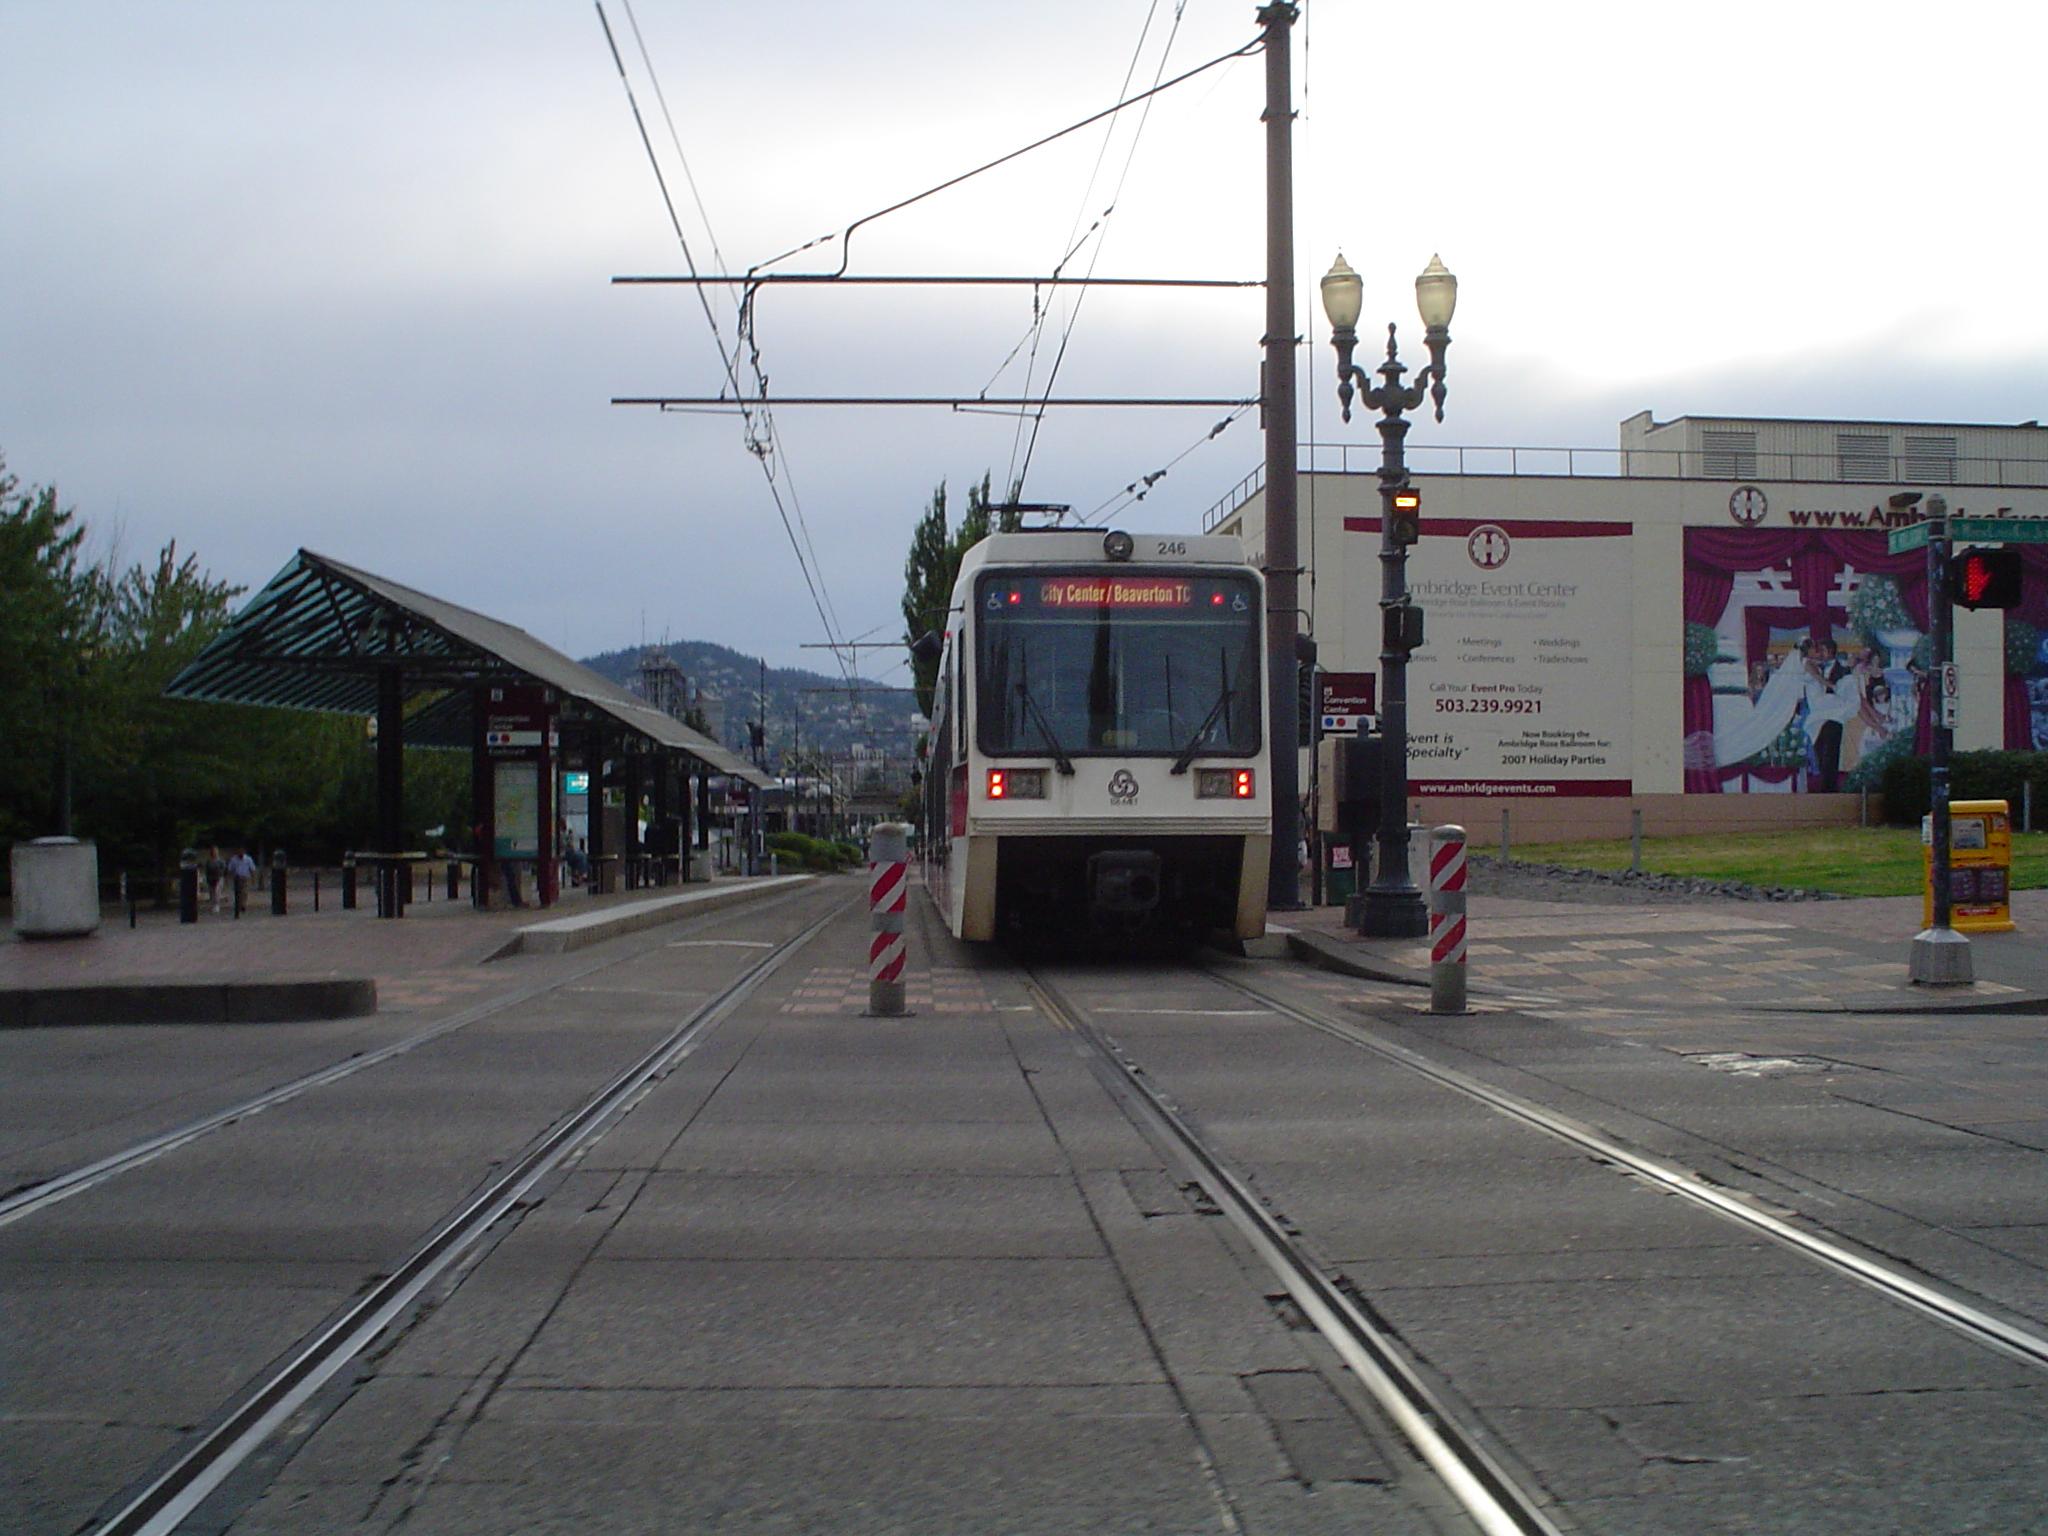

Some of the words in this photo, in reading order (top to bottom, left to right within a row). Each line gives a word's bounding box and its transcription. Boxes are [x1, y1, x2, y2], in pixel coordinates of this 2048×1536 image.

[1158, 542, 1187, 555] 246
[1041, 585, 1063, 605] City
[1067, 584, 1105, 602] Center
[1114, 585, 1173, 602] Beaverton
[1176, 586, 1191, 603] TC
[1481, 582, 1523, 597] Event
[1527, 583, 1578, 598] Center
[1462, 637, 1502, 648] Meetings
[1538, 639, 1580, 649] Weddings
[1462, 655, 1515, 665] Conferences
[1538, 656, 1588, 665] Tradeshows
[1430, 683, 1446, 692] Call
[1447, 684, 1468, 693] Your
[1471, 684, 1497, 693] Event
[1499, 684, 1515, 693] Pro
[1517, 685, 1544, 695] Today
[1435, 699, 1542, 714] 503.239.9921
[1443, 732, 1454, 744] is
[1542, 731, 1575, 740] Booking
[1502, 755, 1526, 765] 2007
[1529, 755, 1569, 767] Holiday
[1571, 755, 1606, 765] Parties
[1420, 783, 1556, 795] www.ambridgeevents.com
